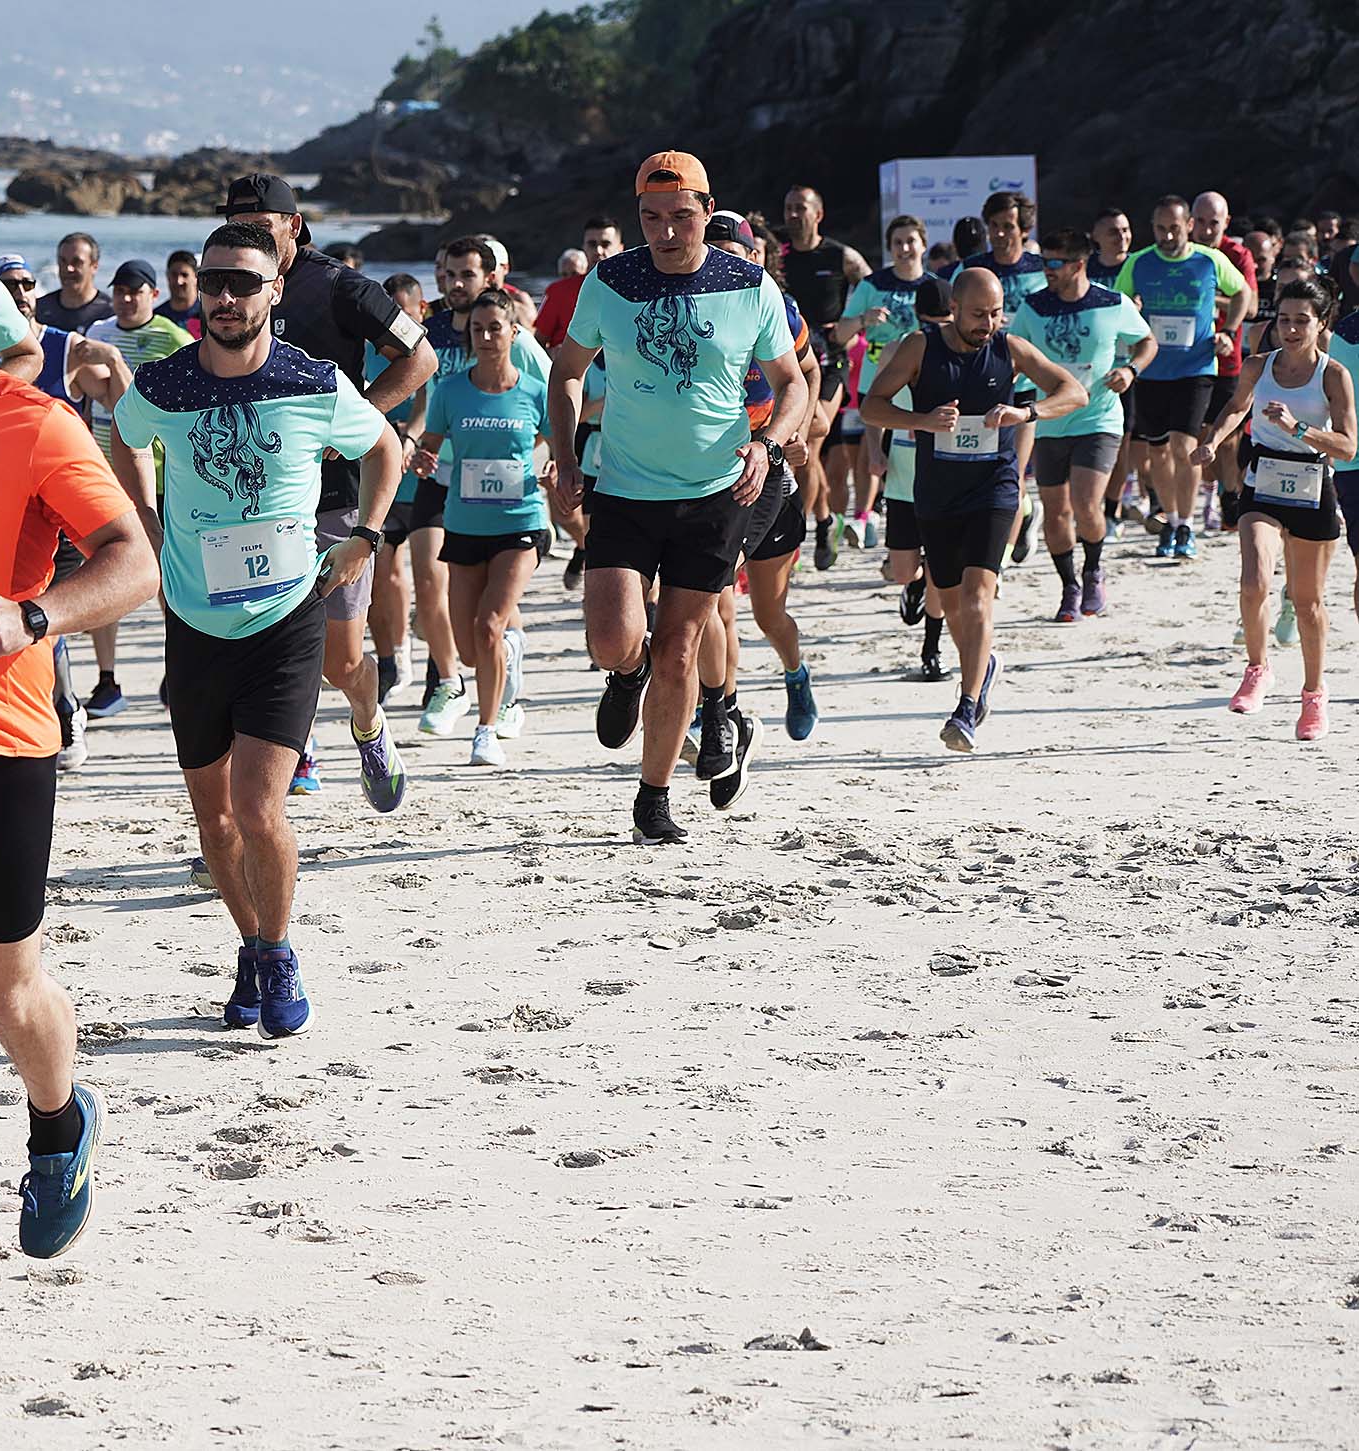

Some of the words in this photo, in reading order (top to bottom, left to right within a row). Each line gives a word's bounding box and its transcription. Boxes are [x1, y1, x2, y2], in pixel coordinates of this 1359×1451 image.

[461, 417, 524, 429] SYNERGYM
[955, 434, 979, 448] 125
[480, 479, 503, 493] 170
[1280, 479, 1296, 494] 13
[241, 543, 263, 552] FELIPE
[244, 554, 270, 579] 12
